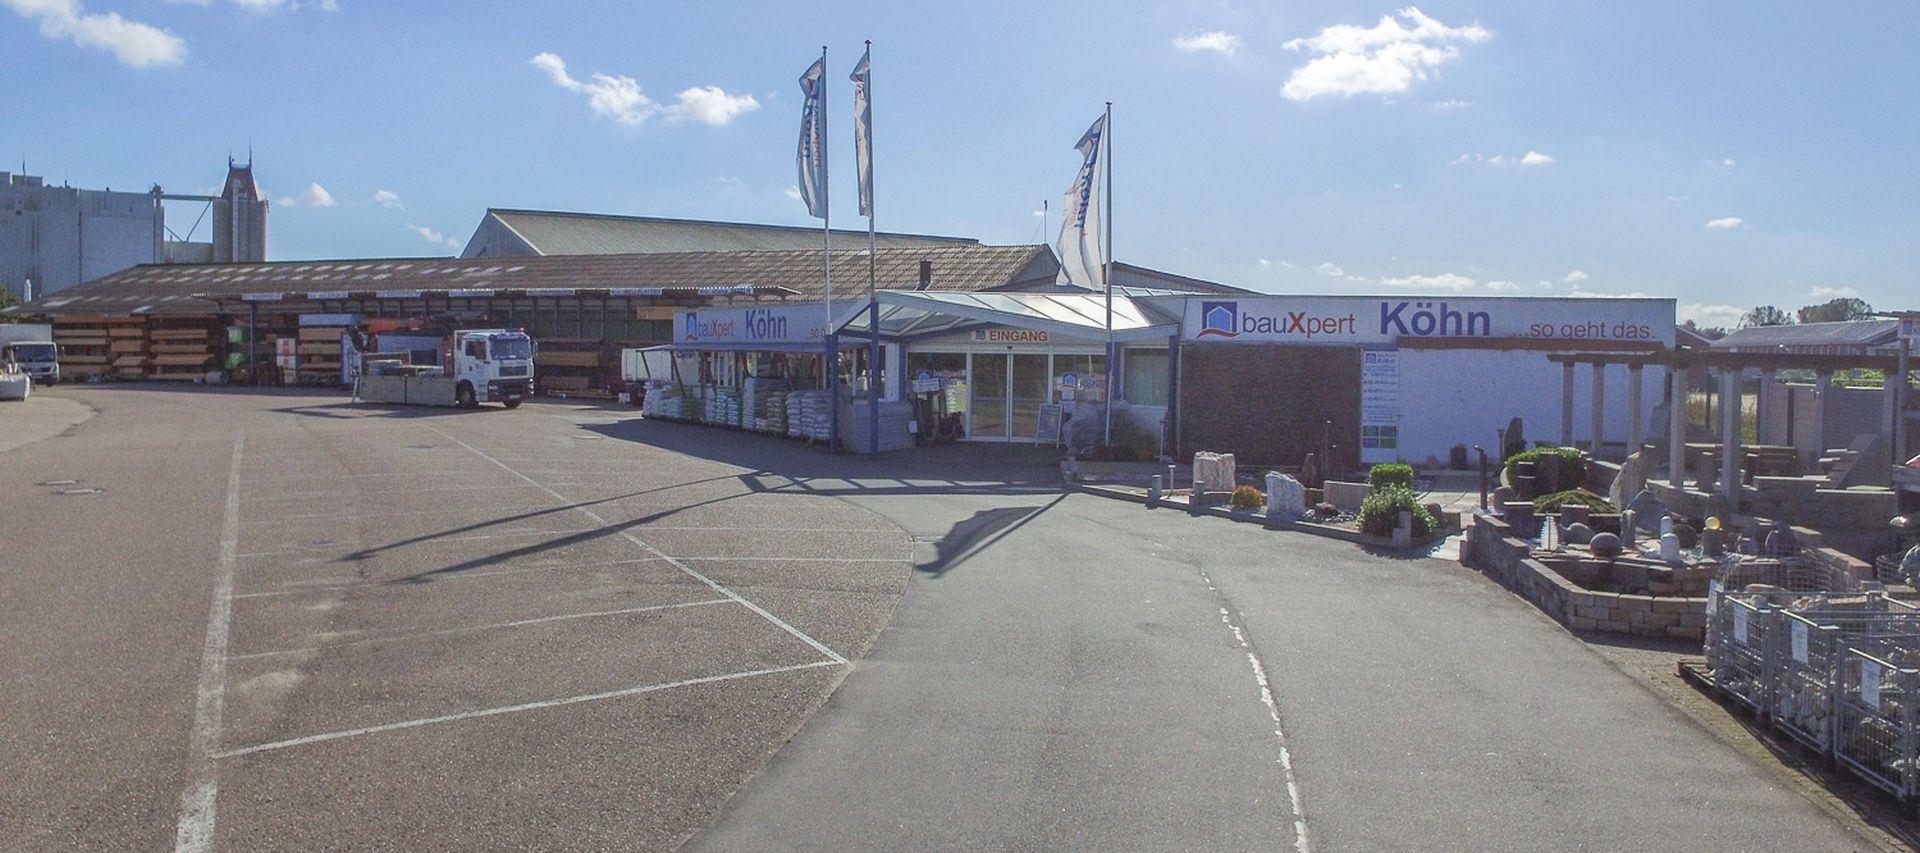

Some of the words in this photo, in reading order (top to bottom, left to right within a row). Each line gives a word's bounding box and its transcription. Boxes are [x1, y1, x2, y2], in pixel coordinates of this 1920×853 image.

[698, 320, 734, 341] bauXpert
[745, 310, 787, 339] Köhn
[989, 330, 1048, 342] EINGANG
[1242, 312, 1356, 338] bauXpert
[1380, 302, 1491, 336] Köhn
[1560, 321, 1606, 339] geht
[1613, 322, 1656, 339] das.
